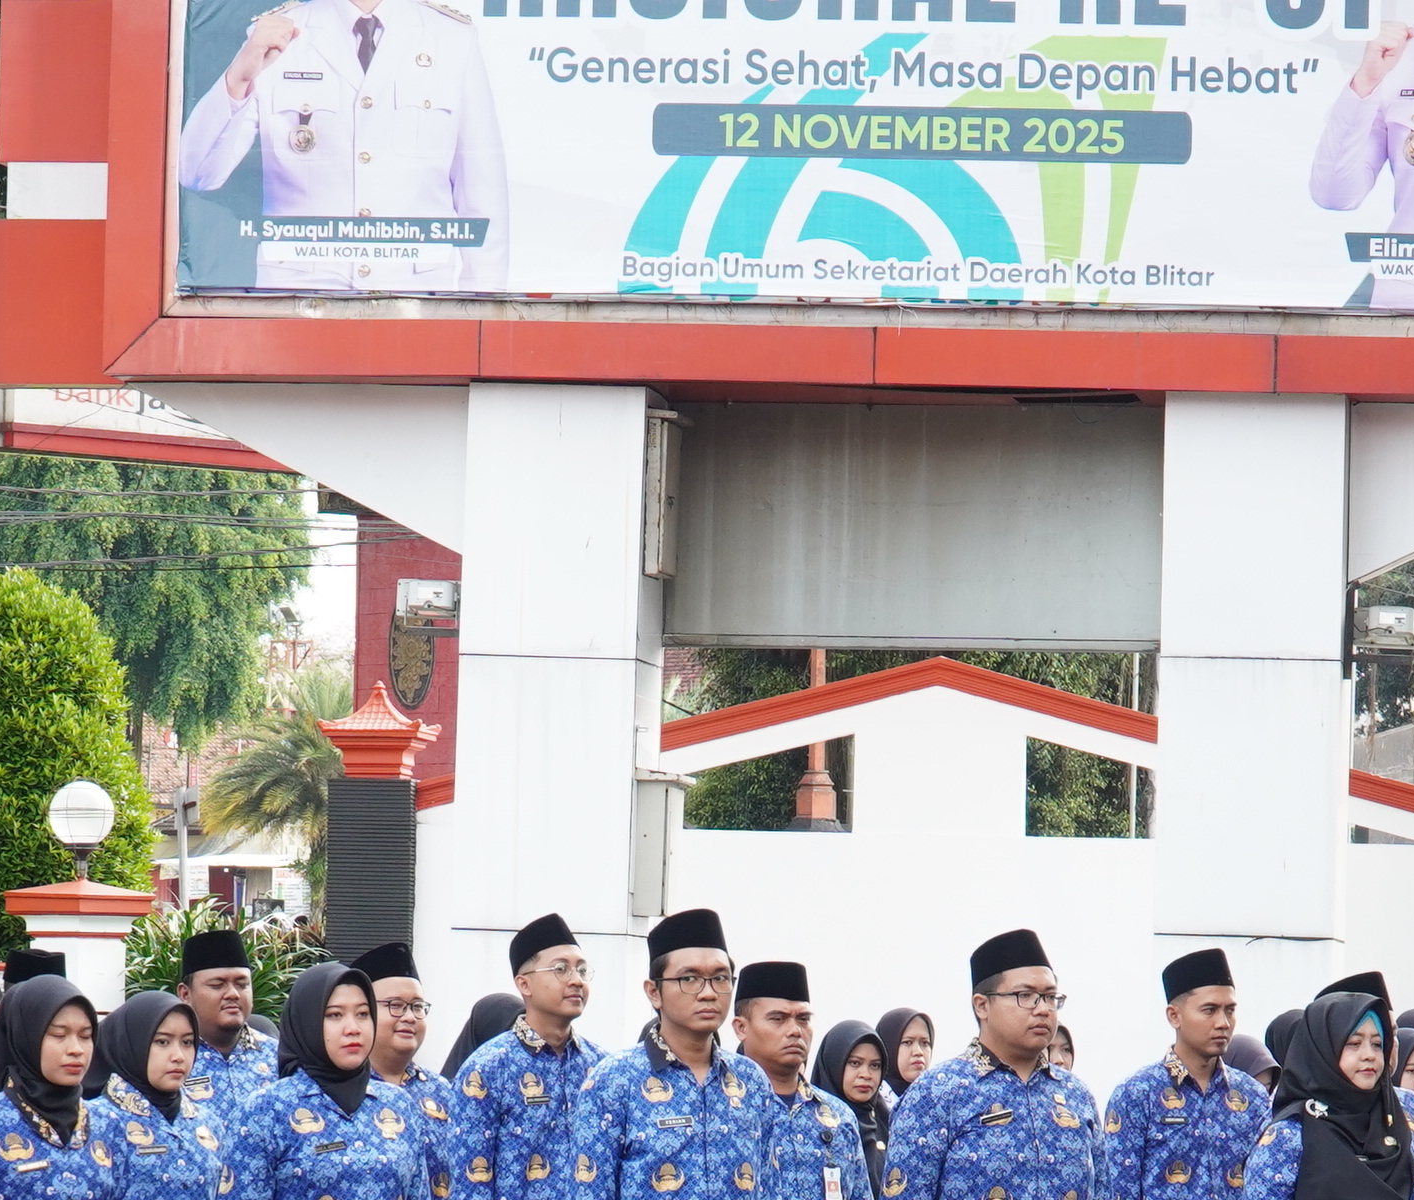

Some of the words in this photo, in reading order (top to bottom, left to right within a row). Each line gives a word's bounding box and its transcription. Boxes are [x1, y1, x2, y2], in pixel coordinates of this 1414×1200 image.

[745, 50, 877, 93] Sehat,
[893, 51, 1003, 89] Masa
[1019, 54, 1155, 99] Depan
[719, 113, 759, 147] 12
[774, 113, 1011, 152] NOVEMBER
[1023, 118, 1125, 154] 2025
[240, 221, 258, 237] H.
[262, 221, 334, 241] Syauqul
[338, 222, 425, 242] Muhibbin,
[430, 223, 475, 240] S.H.I.
[294, 246, 329, 257] WALI
[334, 247, 370, 258] KOTA
[374, 247, 419, 259] BLITAR
[622, 256, 714, 282] Bagian
[723, 257, 804, 279] Umum
[813, 258, 960, 282] Sekretariat
[969, 261, 1067, 284] Daerah
[1076, 263, 1136, 285] Kota
[1145, 264, 1215, 286] Blitar
